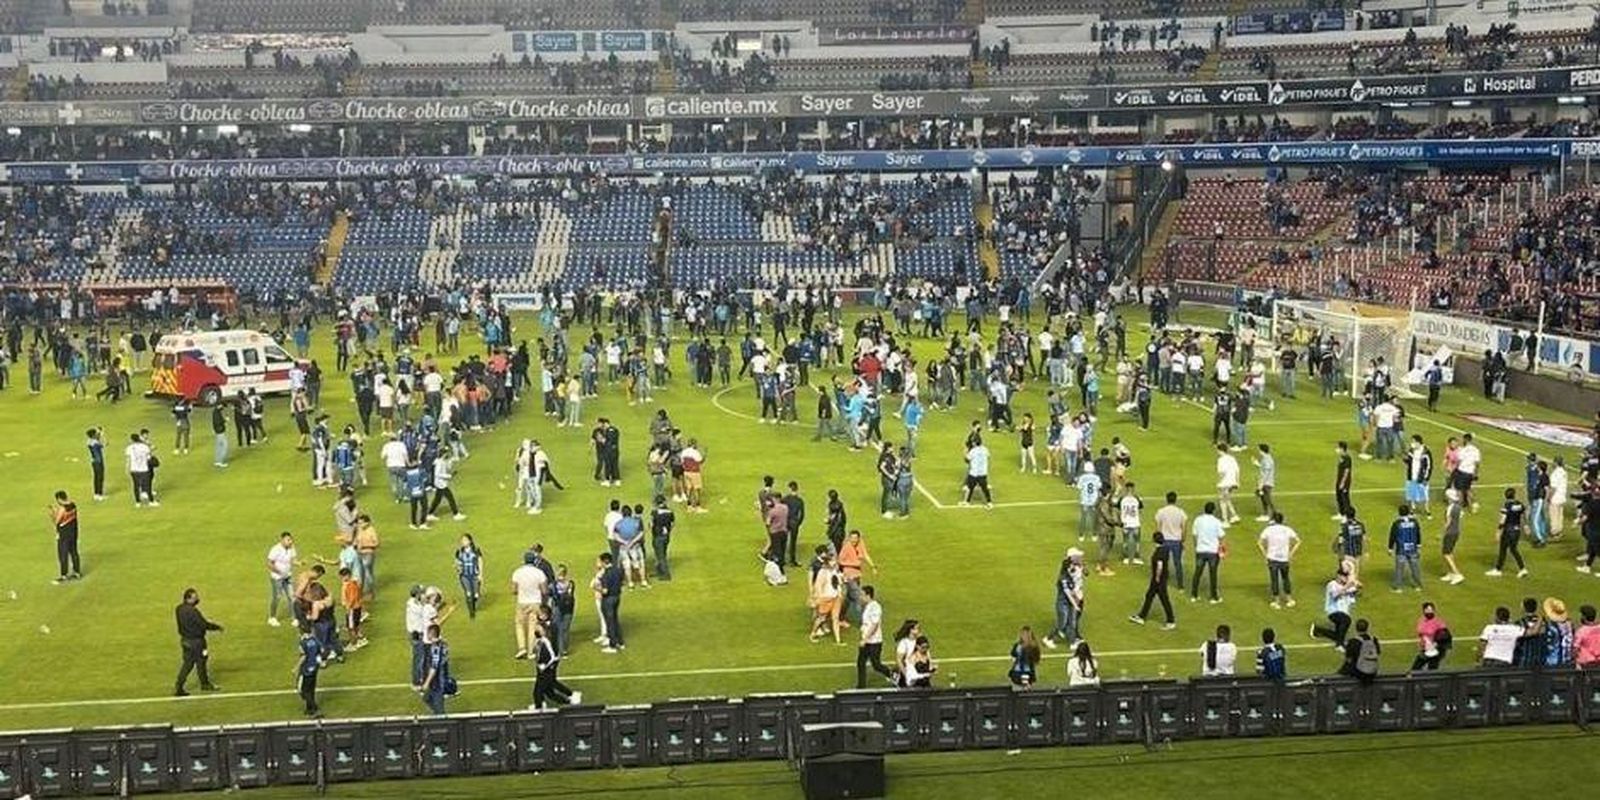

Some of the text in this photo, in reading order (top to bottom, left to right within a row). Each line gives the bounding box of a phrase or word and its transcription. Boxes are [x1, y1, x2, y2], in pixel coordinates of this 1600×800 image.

[534, 34, 574, 49] Sayer
[604, 33, 644, 49] Sayer
[1364, 85, 1392, 97] PETRO
[1483, 76, 1537, 93] Hospital
[1127, 93, 1156, 104] IDEL
[1180, 92, 1209, 103] IDEL
[1233, 91, 1262, 102] IDEL
[1284, 89, 1312, 99] PETRO
[345, 100, 469, 119] Chocke-obleas
[508, 99, 631, 117] Chocke-obleas
[667, 98, 779, 115] caliente.mx
[801, 94, 854, 114] Sayer
[872, 93, 924, 114] Sayer
[180, 102, 306, 121] Chocke-obleas
[644, 155, 709, 168] caliente.mx
[722, 154, 787, 168] caliente.mx
[816, 153, 856, 168] Sayer
[885, 152, 925, 167] Sayer
[1087, 482, 1094, 494] 8
